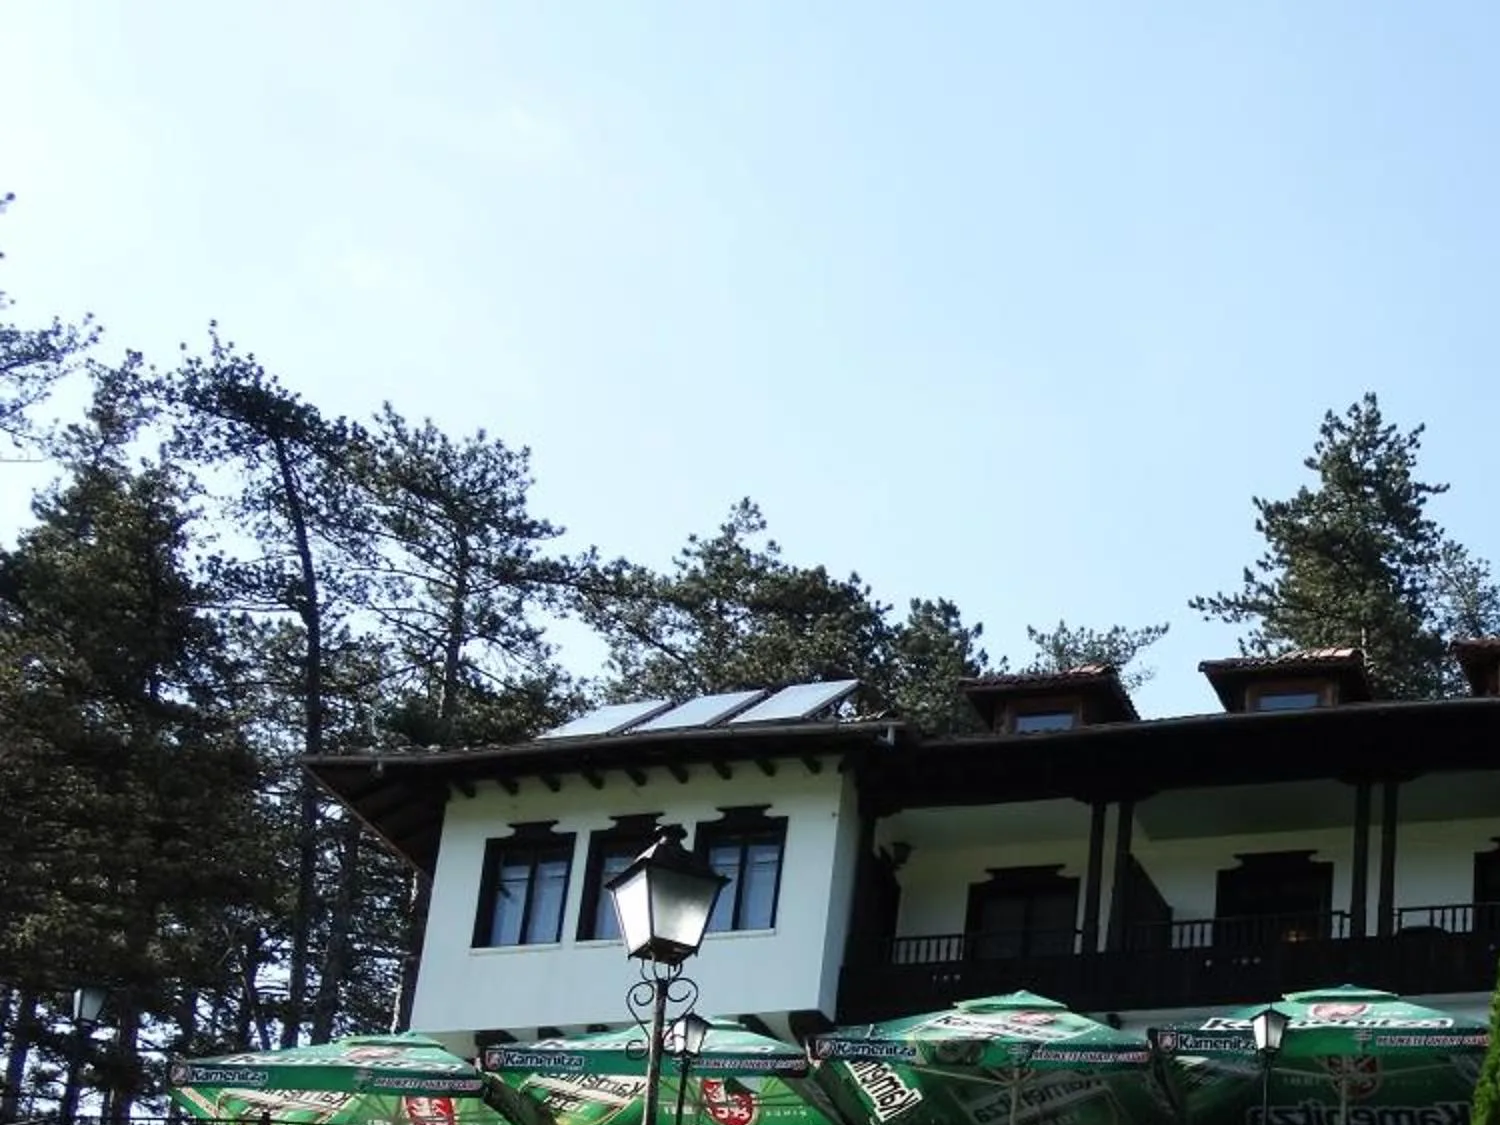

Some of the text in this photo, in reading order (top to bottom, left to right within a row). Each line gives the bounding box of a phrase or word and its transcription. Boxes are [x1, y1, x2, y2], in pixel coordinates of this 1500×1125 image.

[833, 1041, 917, 1058] Kamenitza
[1178, 1033, 1256, 1054] Kamenitza
[503, 1053, 584, 1070] Kamenitza
[191, 1069, 268, 1086] Kamenitza
